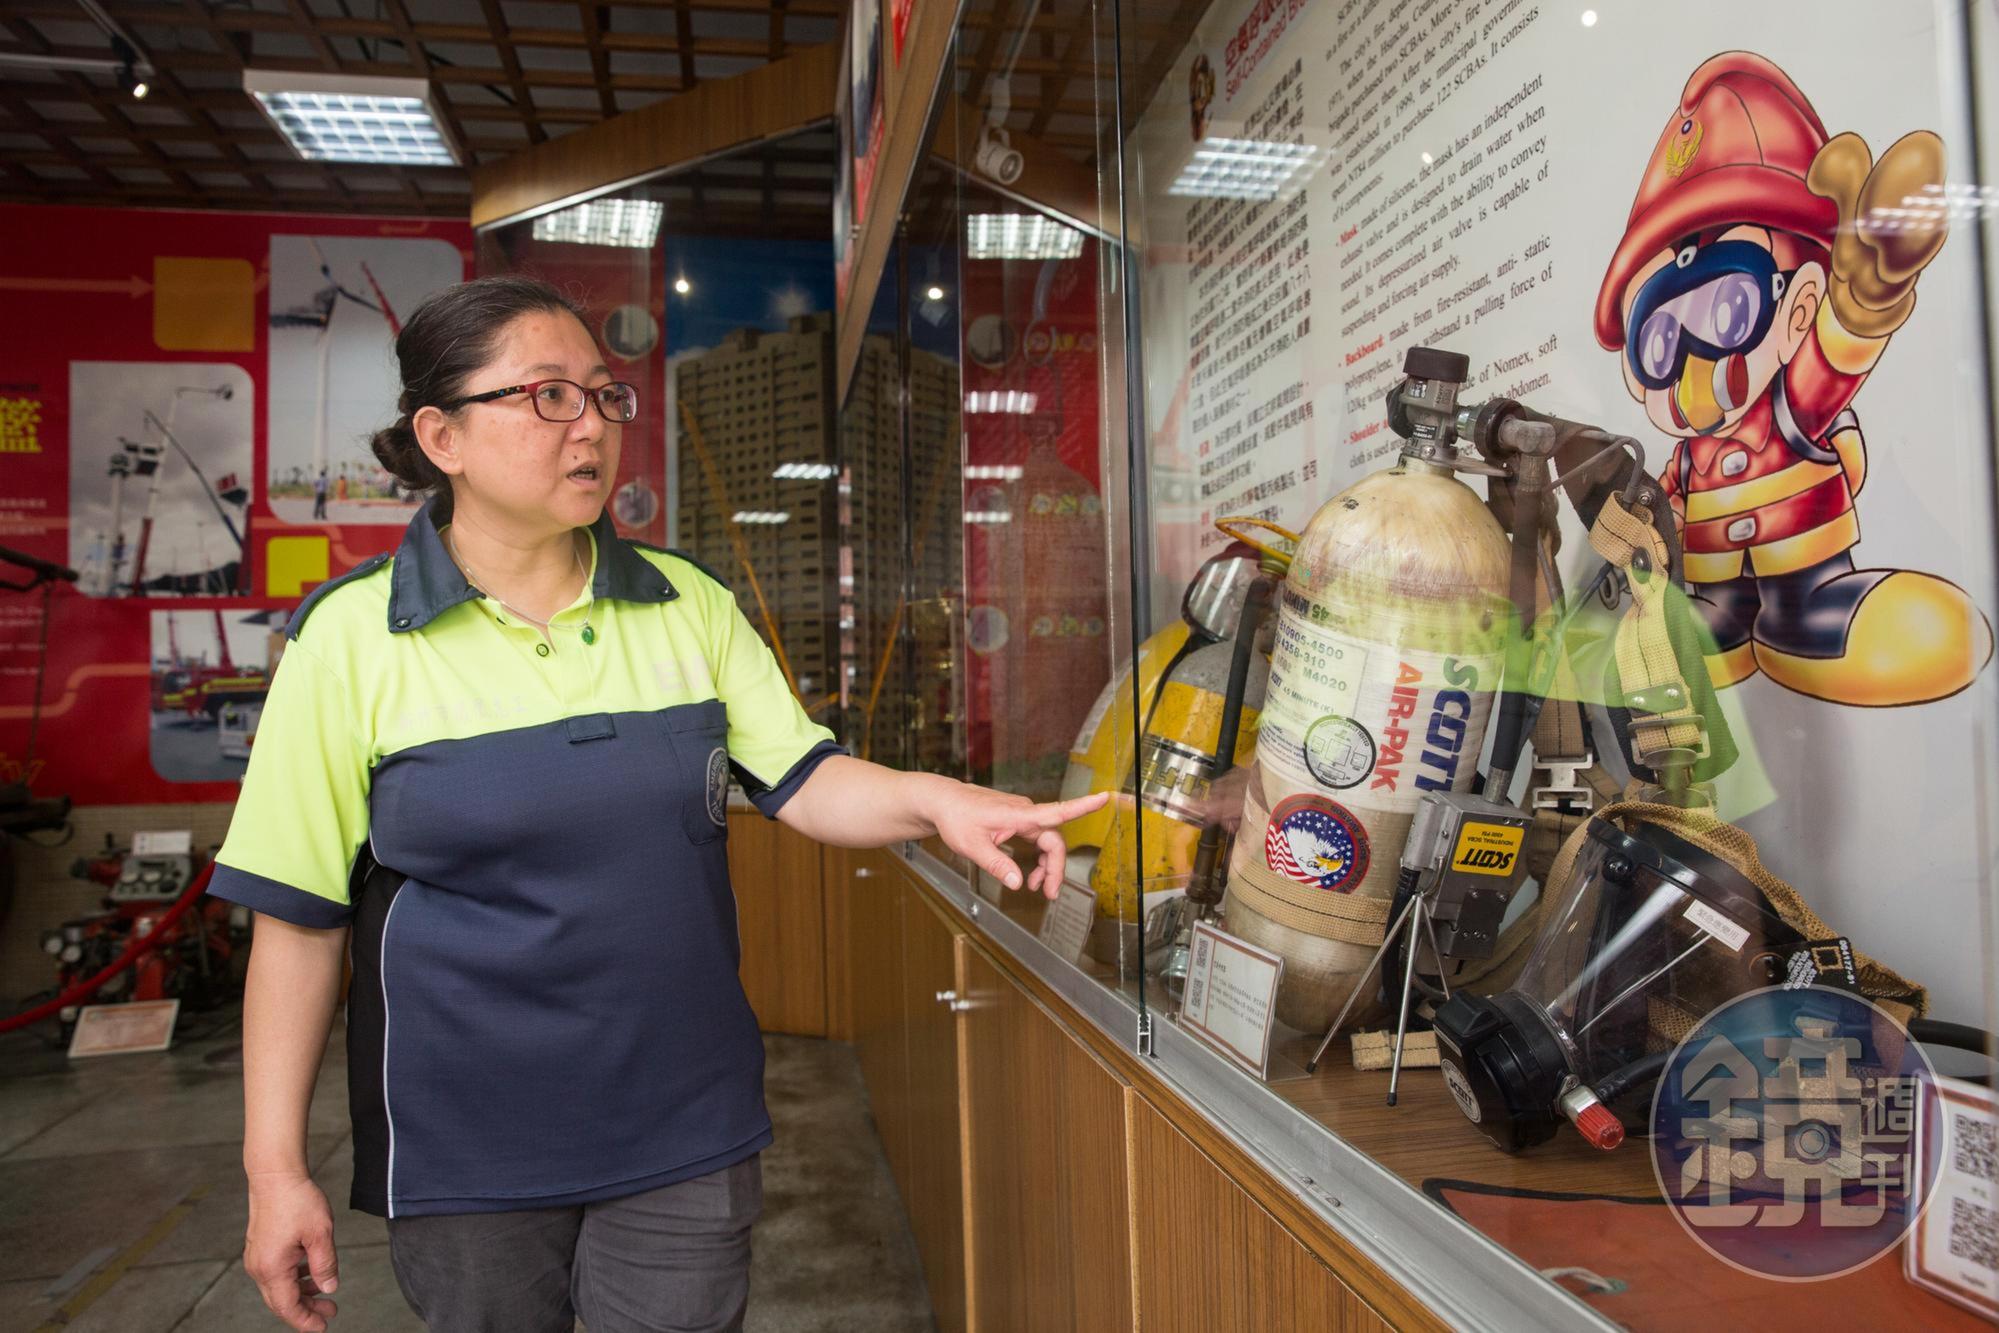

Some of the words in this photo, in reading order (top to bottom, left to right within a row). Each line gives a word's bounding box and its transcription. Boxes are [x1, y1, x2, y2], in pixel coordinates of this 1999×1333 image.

[1401, 102, 1435, 141] purchase
[1436, 83, 1452, 106] 122
[1453, 52, 1488, 91] SCBAs.
[1490, 42, 1499, 59] It
[1499, 6, 1540, 49] consists
[1419, 77, 1432, 95] the
[1435, 30, 1477, 80] municipal
[1423, 46, 1436, 65] the
[1439, 20, 1461, 49] city's
[1465, 5, 1481, 25] fire
[1386, 216, 1399, 234] and
[1401, 207, 1409, 222] is
[1411, 181, 1445, 215] designed
[1448, 173, 1456, 187] to
[1459, 151, 1483, 177] drain
[1486, 126, 1513, 156] water
[1516, 104, 1546, 133] when
[1419, 165, 1432, 182] the
[1432, 145, 1454, 171] mask
[1455, 132, 1470, 154] has
[1471, 124, 1483, 141] an
[1484, 72, 1544, 131] independent
[1372, 244, 1395, 270] comes
[1395, 217, 1429, 253] complete
[1430, 204, 1449, 226] with
[1450, 195, 1464, 212] the
[1466, 169, 1495, 200] ability
[1498, 162, 1508, 179] to
[1511, 134, 1548, 170] convey
[1432, 234, 1444, 252] air
[1449, 216, 1473, 241] valve
[1478, 205, 1488, 222] is
[1493, 176, 1530, 212] capable
[1537, 160, 1550, 182] of
[1377, 298, 1391, 315] and
[1391, 280, 1418, 306] forcing
[1419, 272, 1429, 289] air
[1431, 253, 1461, 281] supply.
[1389, 320, 1409, 341] made
[1413, 307, 1432, 328] from
[1436, 272, 1492, 315] fire-resistant,
[1496, 253, 1518, 279] anti-
[1524, 233, 1552, 262] static
[1422, 315, 1461, 348] withstand
[1464, 313, 1471, 326] a
[1474, 294, 1506, 325] pulling
[1510, 275, 1536, 300] force
[1541, 260, 1554, 282] of
[1479, 360, 1492, 382] of
[1493, 347, 1534, 378] Nomex,
[1538, 333, 1559, 358] soft
[1504, 373, 1552, 401] abdomen.
[1302, 666, 1347, 692] M4020
[1414, 656, 1479, 792] SCOTT
[1370, 661, 1423, 792] AIR-PAK
[1459, 848, 1515, 870] SCOTT
